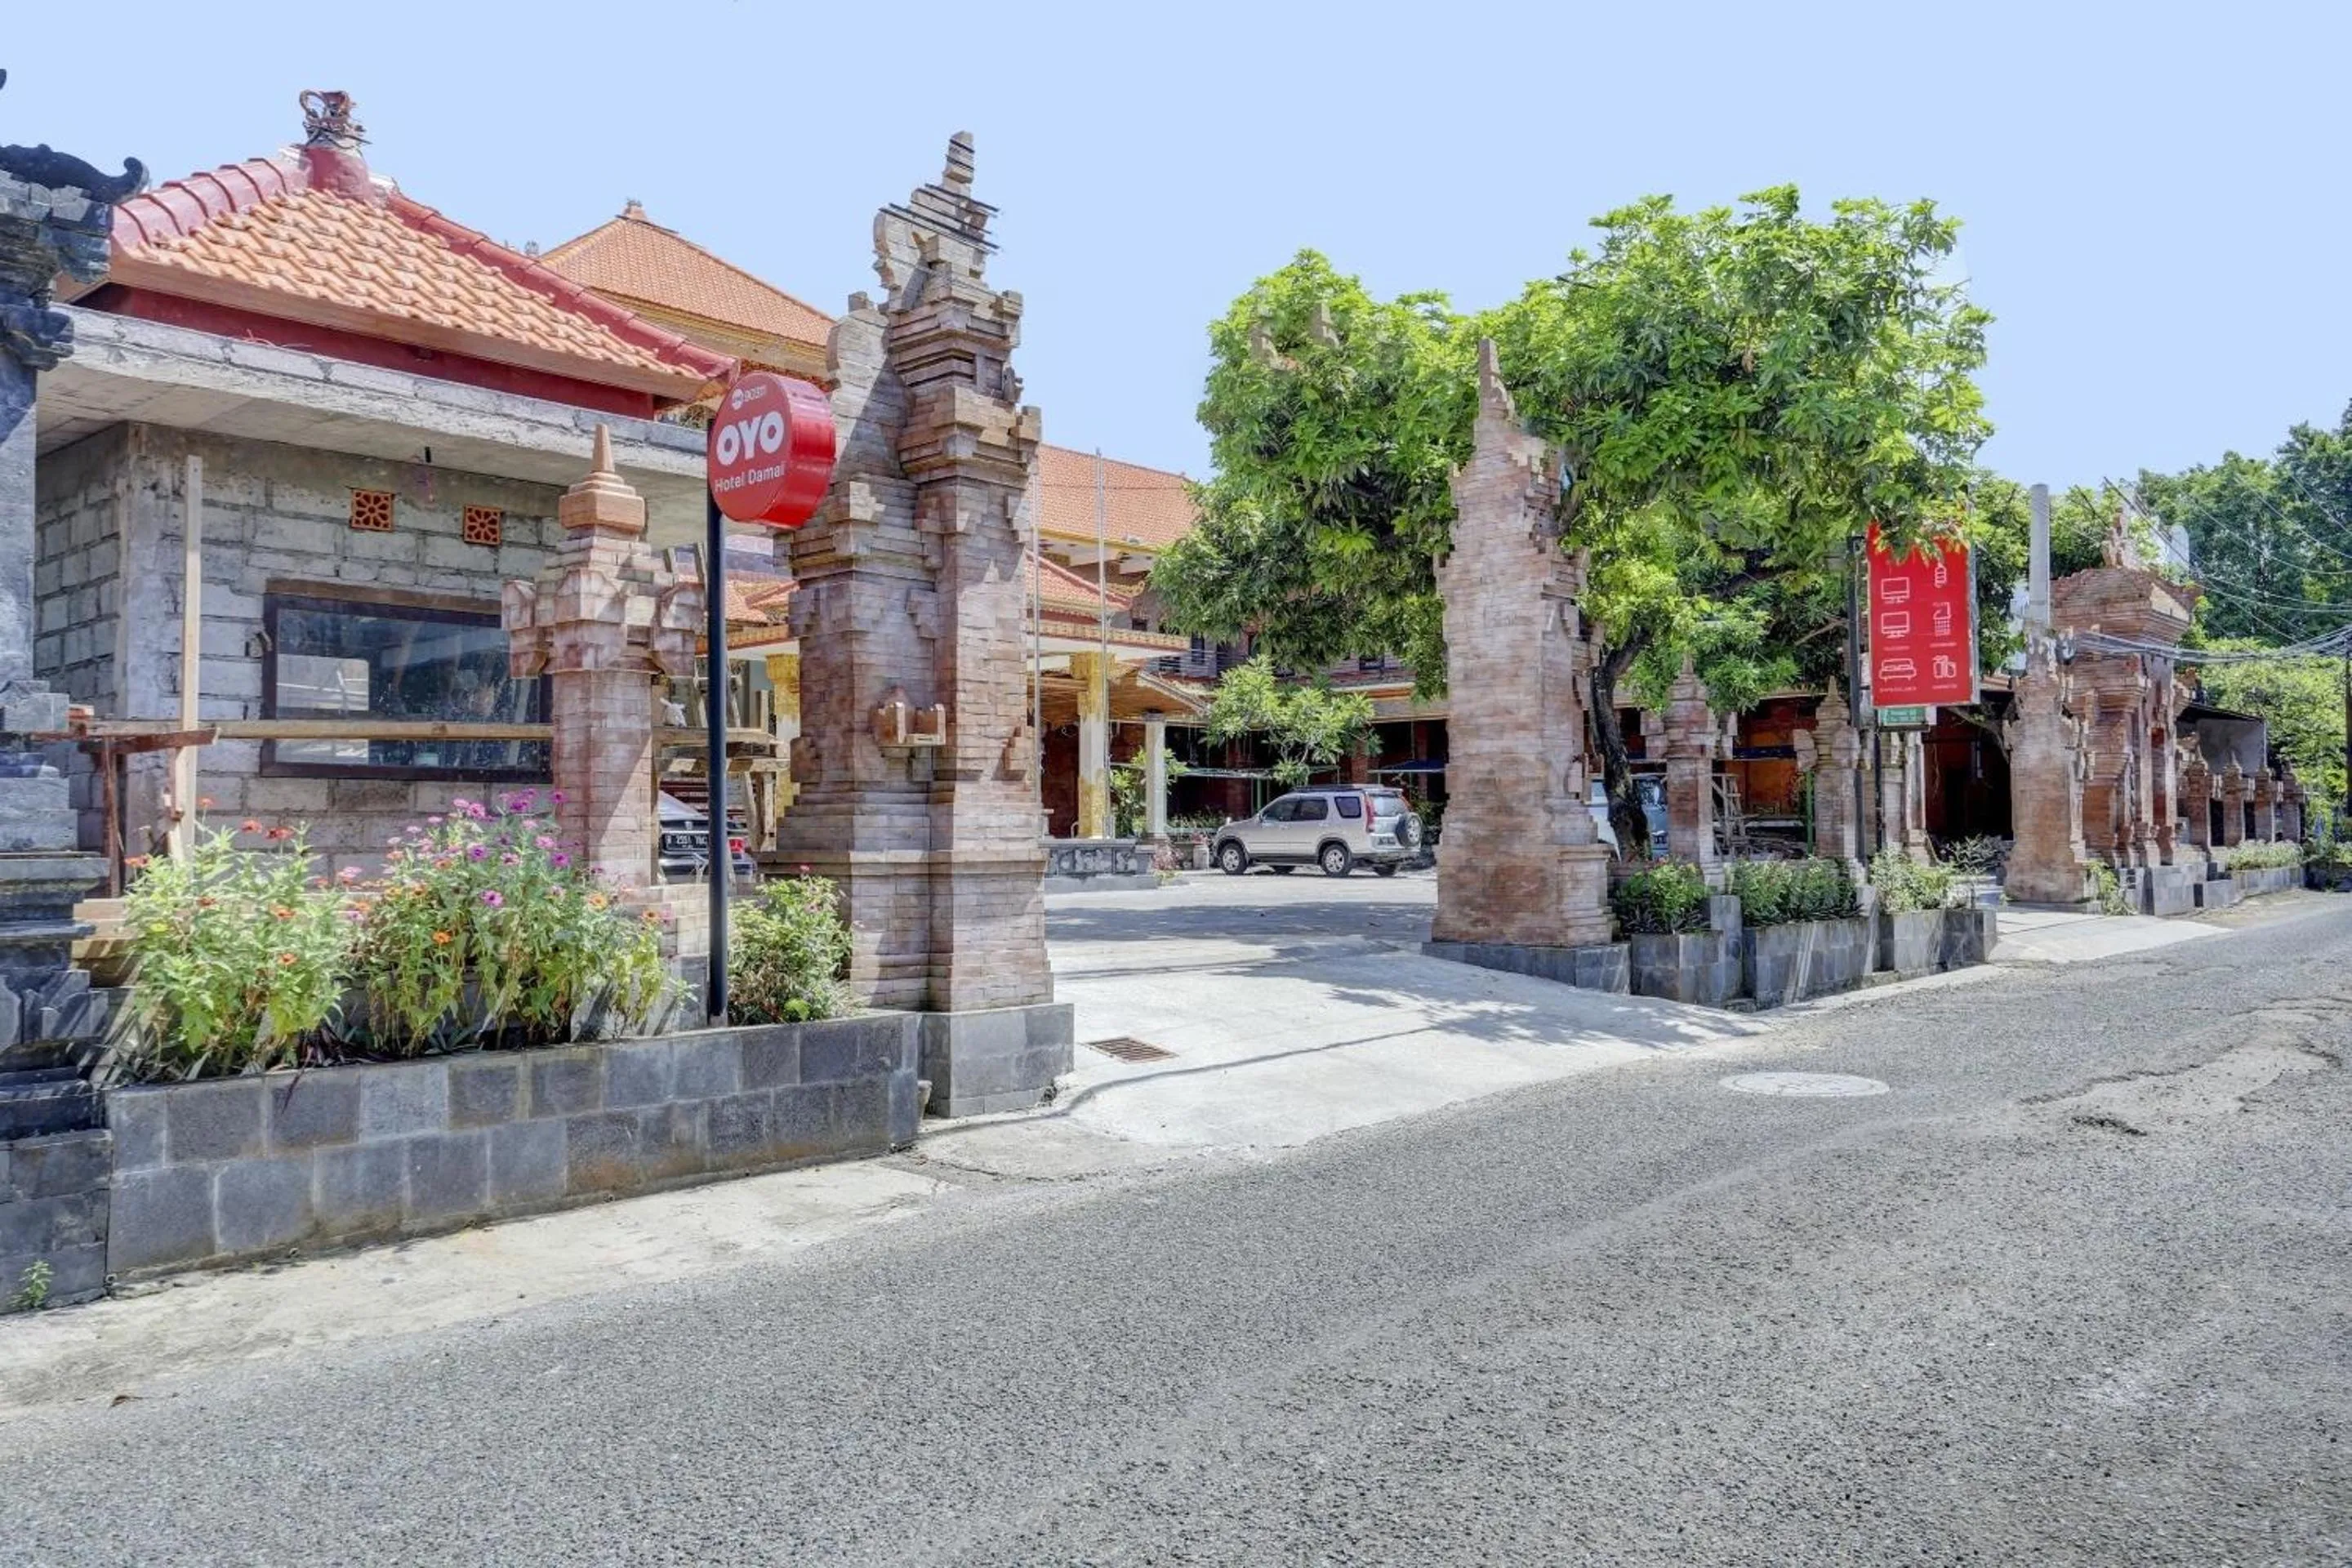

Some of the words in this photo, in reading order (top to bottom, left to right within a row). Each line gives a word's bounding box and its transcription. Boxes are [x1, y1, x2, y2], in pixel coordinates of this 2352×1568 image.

[717, 412, 784, 466] OYO
[715, 471, 745, 493] Hotel
[748, 462, 786, 484] Damai
